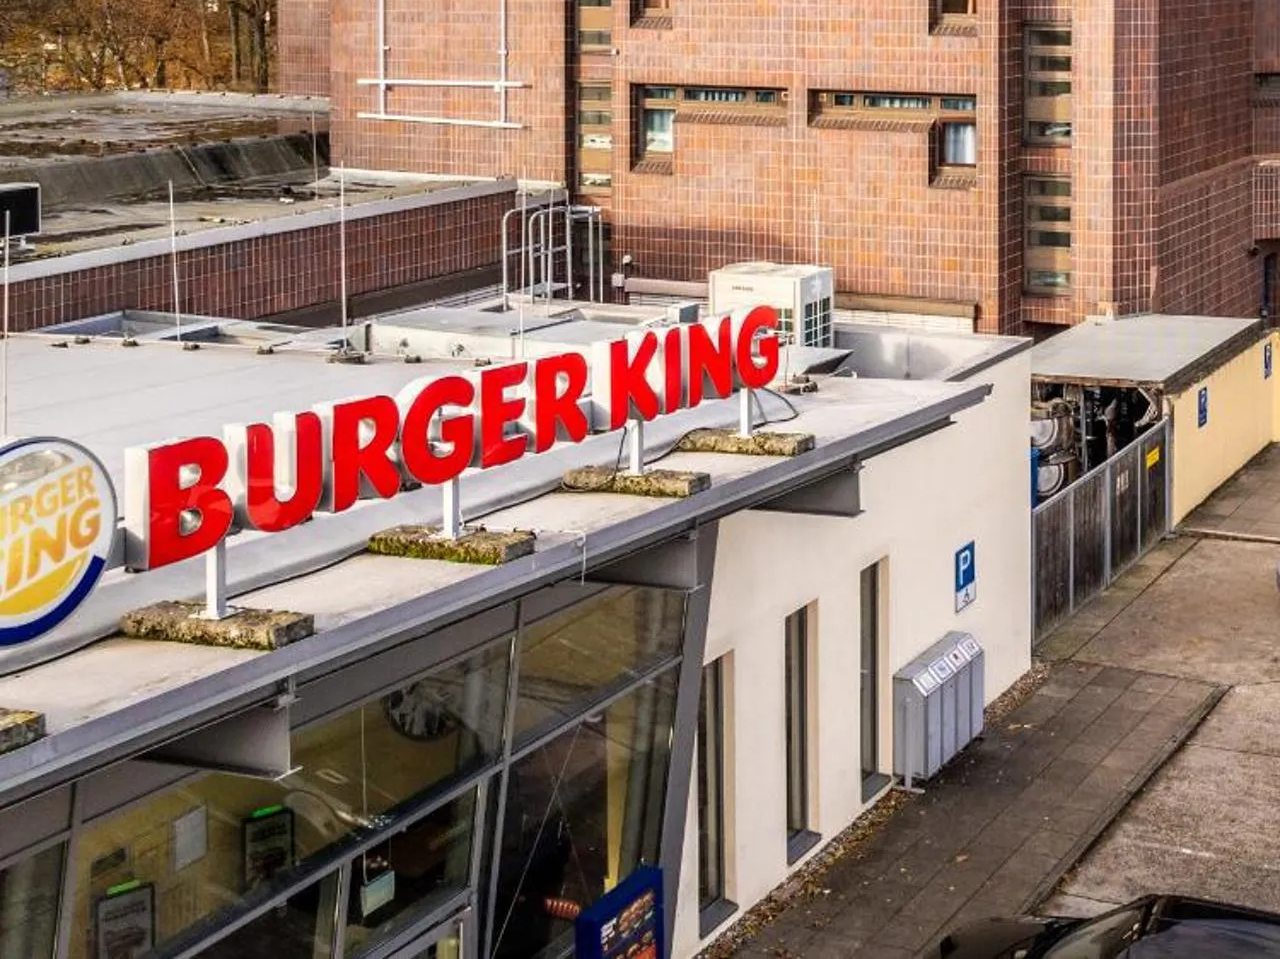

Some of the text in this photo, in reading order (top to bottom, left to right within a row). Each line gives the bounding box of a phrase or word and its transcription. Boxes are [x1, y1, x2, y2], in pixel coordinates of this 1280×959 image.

[149, 305, 780, 569] BURGER KING
[0, 464, 96, 539] RGER
[0, 497, 101, 591] ING
[959, 549, 971, 586] P
